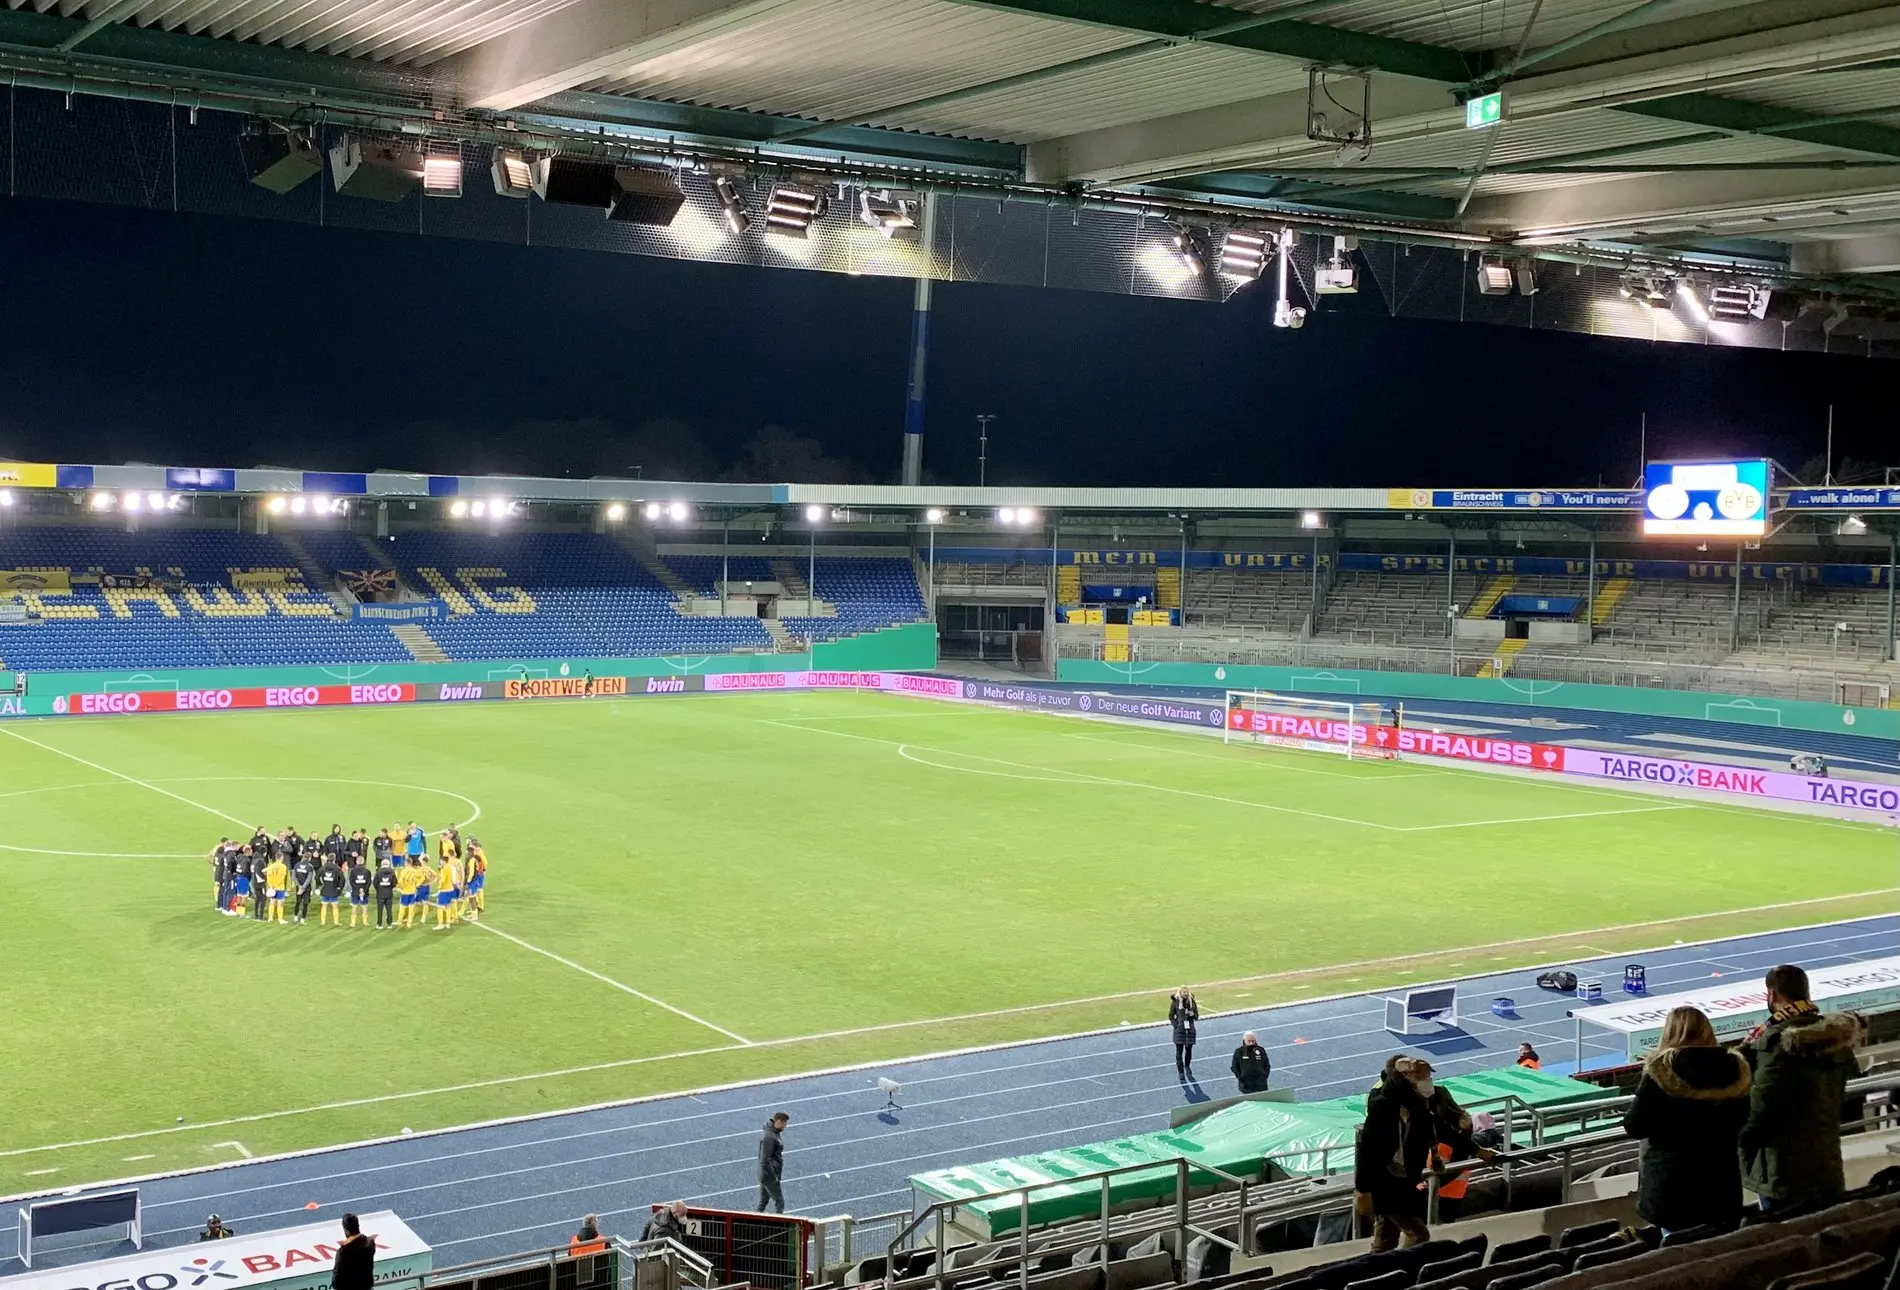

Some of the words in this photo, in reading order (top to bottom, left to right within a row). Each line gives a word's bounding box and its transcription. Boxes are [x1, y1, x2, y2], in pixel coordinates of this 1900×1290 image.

[1453, 491, 1504, 501] Eintracht
[1561, 494, 1594, 505] You'll
[1798, 492, 1839, 504] ...walk
[1842, 492, 1880, 503] alone!
[17, 674, 25, 683] 12
[647, 676, 684, 693] bwin
[722, 673, 785, 687] BAUHAUS
[807, 672, 881, 686] BAUHAUS
[903, 677, 957, 695] BAUHAUS
[176, 690, 233, 709] ERGO
[265, 687, 320, 706] ERGO
[351, 684, 402, 703] ERGO
[440, 681, 482, 700] bwin
[983, 686, 1005, 698] Mehr
[1006, 689, 1024, 701] Golf
[1025, 692, 1037, 703] als
[1038, 693, 1047, 705] je
[1048, 695, 1071, 706] zuvor
[0, 698, 27, 714] AL
[81, 693, 140, 713] ERGO
[1098, 698, 1114, 710] Der
[1116, 702, 1139, 713] neue
[1140, 703, 1162, 716] Golf
[1163, 705, 1202, 720] Variant
[1251, 713, 1367, 744] STRAUSS
[1397, 731, 1533, 765] STRAUSS
[690, 1222, 697, 1235] 2
